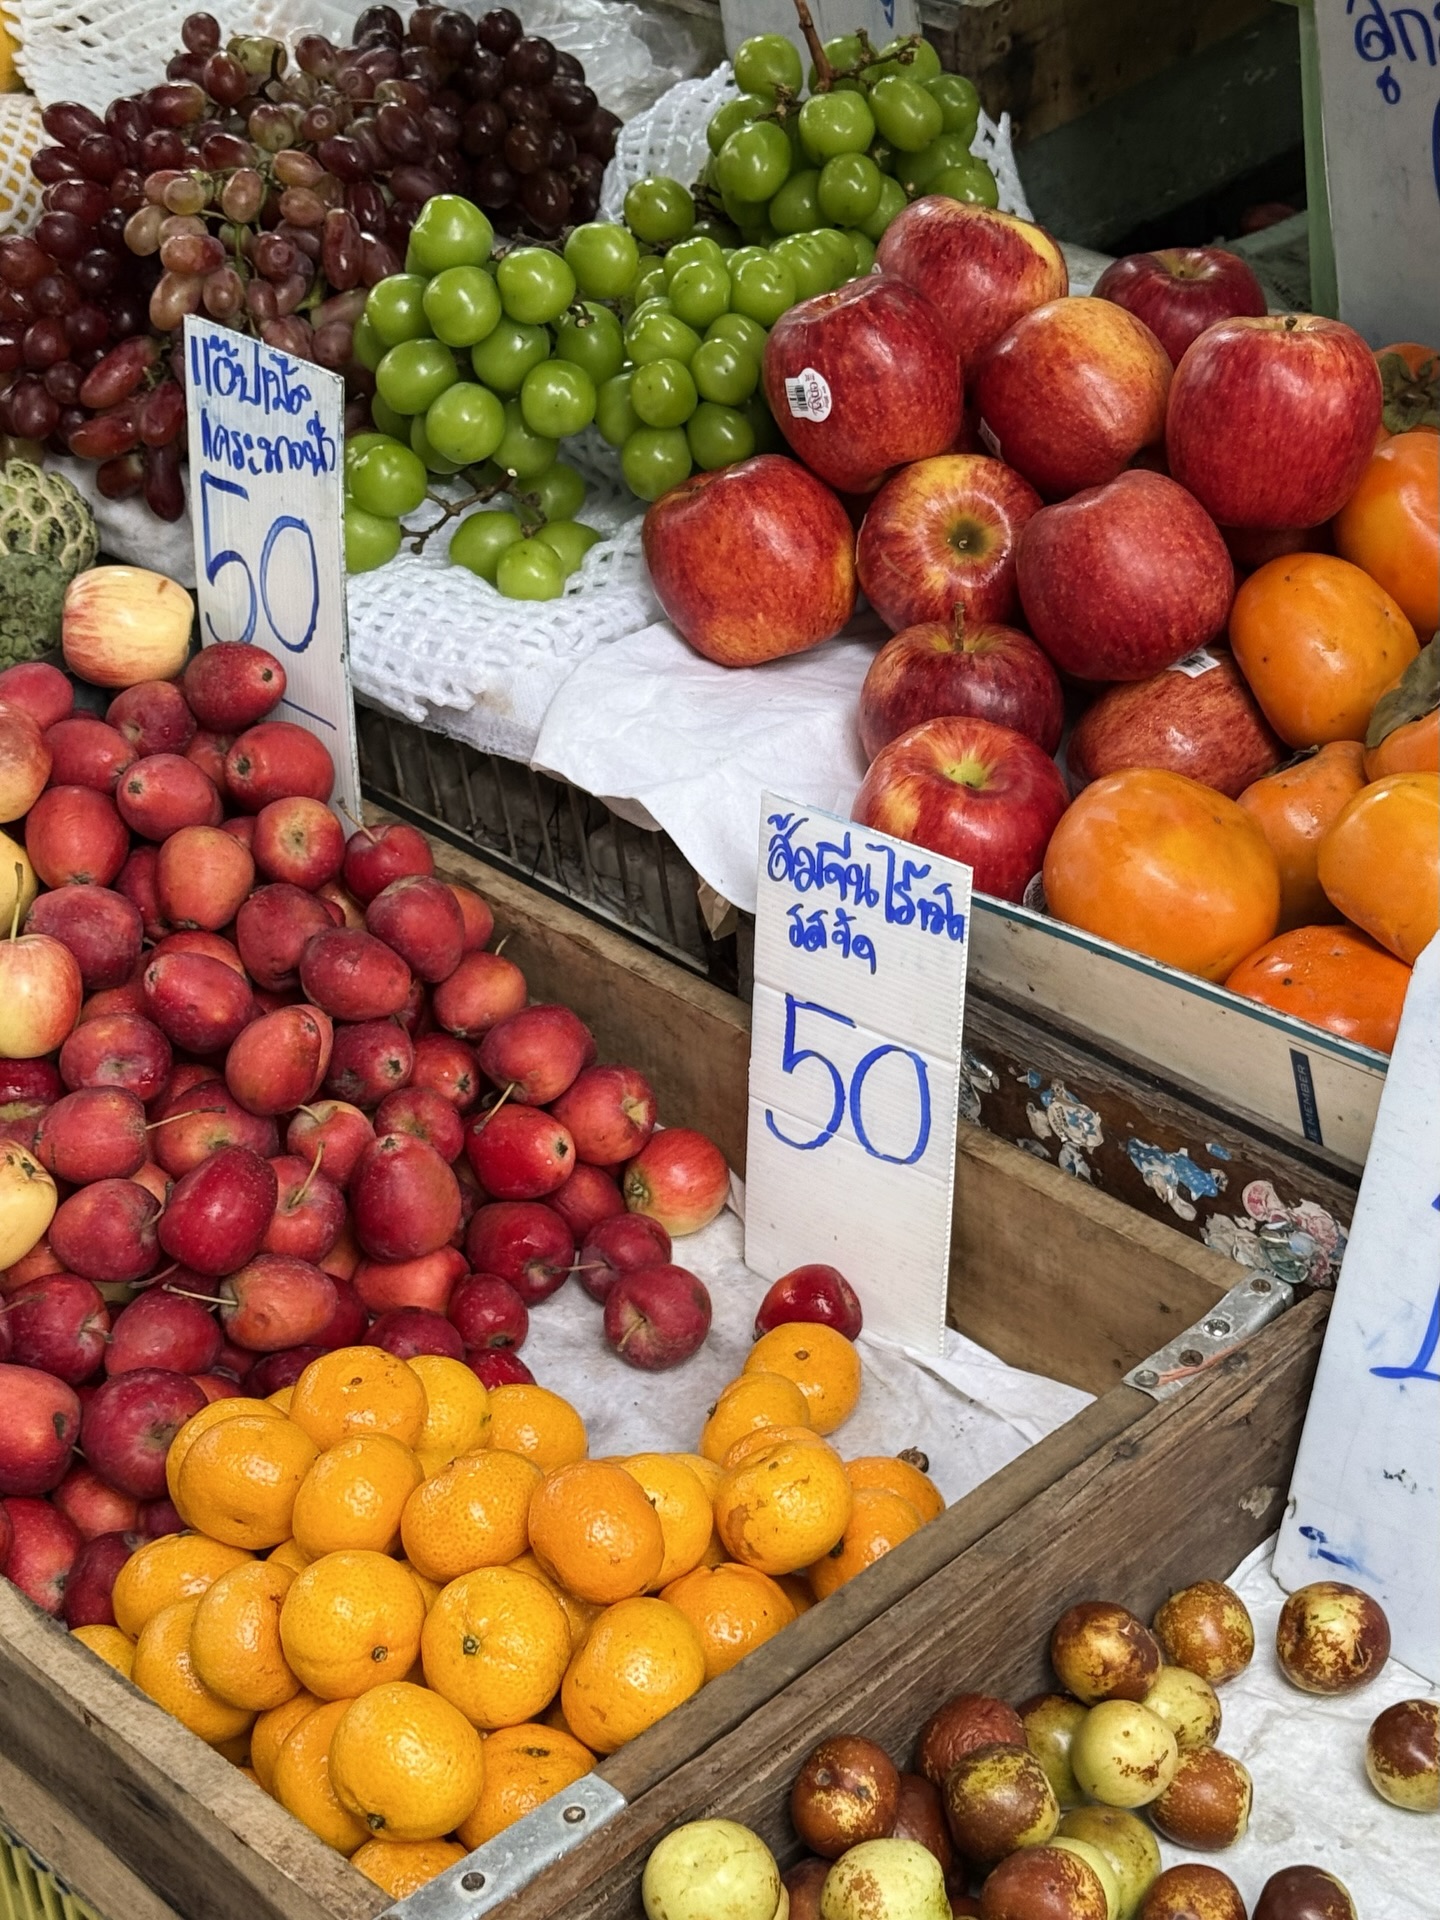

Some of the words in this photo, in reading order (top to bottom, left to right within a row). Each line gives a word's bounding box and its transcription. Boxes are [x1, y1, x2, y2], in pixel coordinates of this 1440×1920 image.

[200, 469, 319, 654] 50
[764, 991, 932, 1166] 50
[1297, 1064, 1315, 1125] MEMBER
